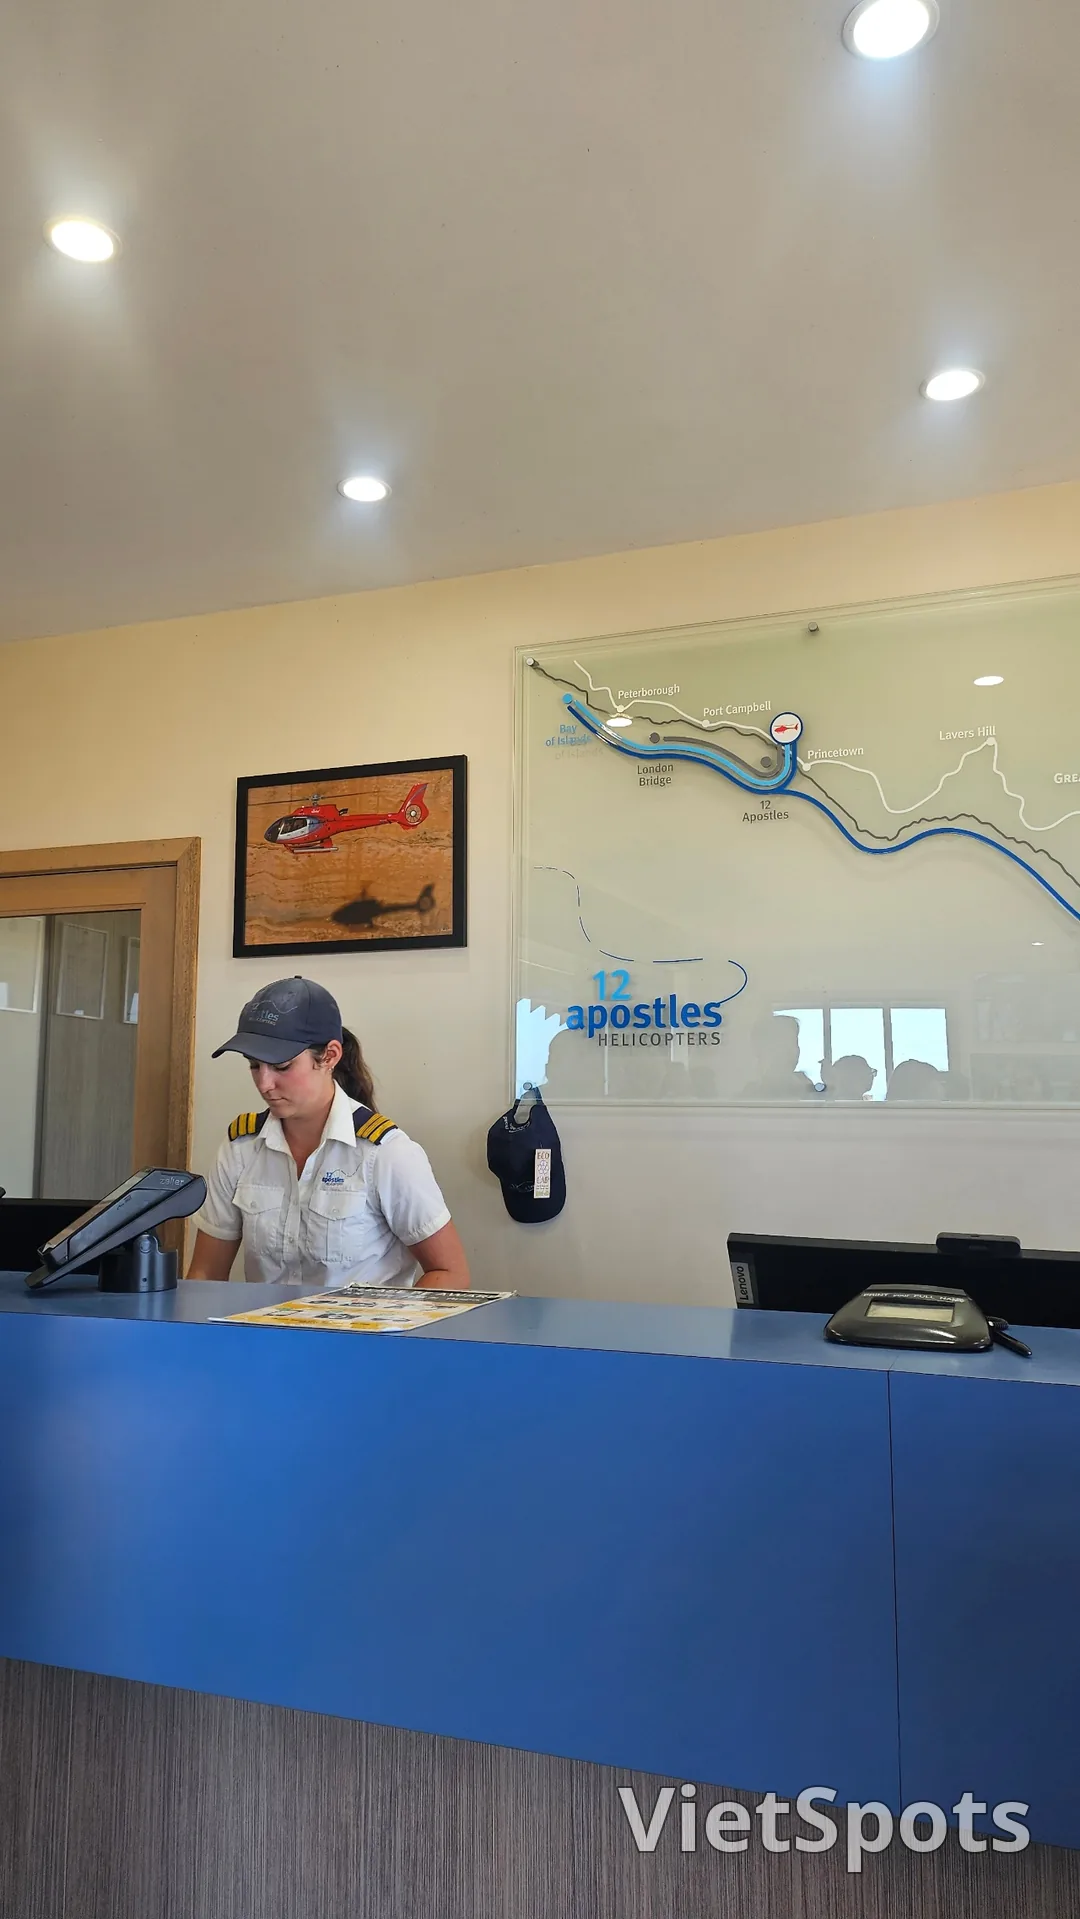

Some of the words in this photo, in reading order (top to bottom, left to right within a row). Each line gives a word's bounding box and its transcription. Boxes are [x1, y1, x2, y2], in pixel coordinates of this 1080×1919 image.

[618, 684, 680, 699] Peterborough
[703, 707, 723, 717] Port
[726, 701, 771, 715] Campbell
[560, 724, 577, 734] Bay
[939, 730, 975, 740] Lavers
[977, 725, 996, 737] Hill
[545, 737, 555, 747] of
[558, 733, 592, 746] Islands
[807, 748, 864, 759] Princetown
[637, 763, 674, 774] London
[639, 776, 672, 787] Bridge
[1053, 772, 1080, 784] GRE
[760, 800, 771, 809] 12
[742, 810, 789, 823] Apostles
[592, 968, 632, 1001] 12
[566, 994, 722, 1038] apostles
[598, 1032, 721, 1046] HELICOPTERS
[537, 1151, 550, 1160] ECO
[736, 1266, 749, 1301] Lenovo
